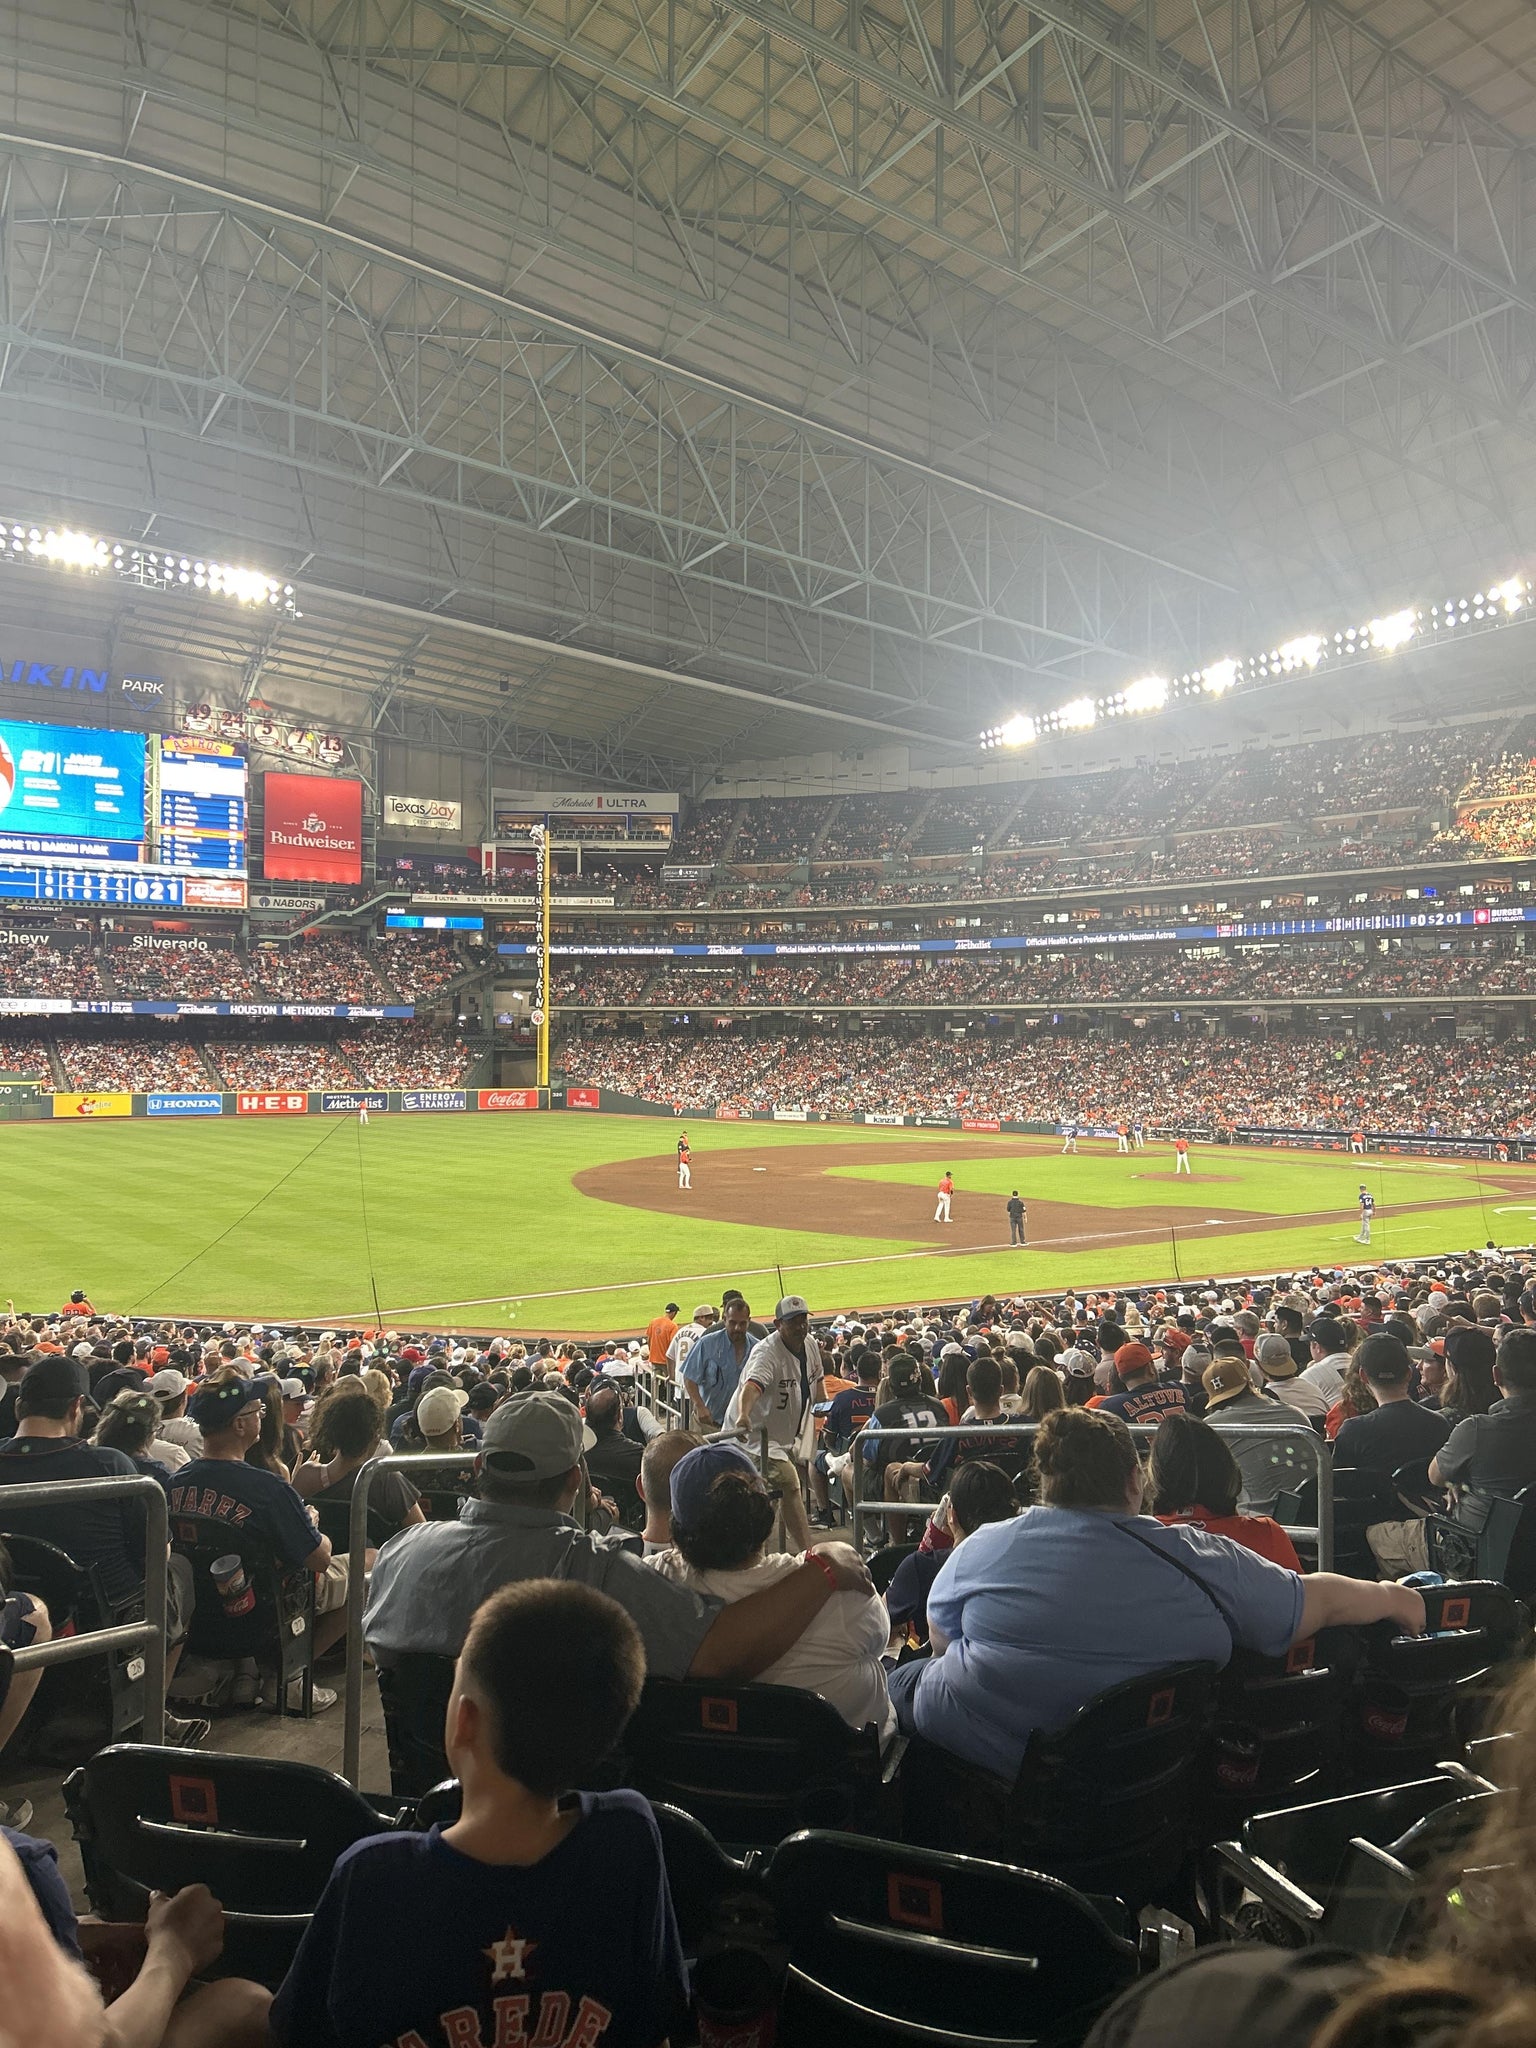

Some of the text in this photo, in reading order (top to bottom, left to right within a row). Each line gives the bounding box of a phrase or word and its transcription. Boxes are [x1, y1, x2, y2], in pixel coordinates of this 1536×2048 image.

[0, 660, 108, 693] IKIN
[122, 680, 165, 695] PARK
[188, 703, 211, 720] 49
[222, 711, 244, 728] 24
[262, 719, 273, 734] 5
[295, 729, 306, 743] 7
[322, 735, 343, 752] 13
[173, 738, 222, 755] ASTROS
[389, 798, 456, 821] Texas Bay
[552, 797, 647, 808] Michelob ULTRA
[25, 840, 40, 851] TO
[80, 844, 109, 856] PARK
[536, 852, 544, 891] ROOT
[273, 898, 316, 909] NABORS
[536, 896, 544, 907] 4
[1491, 908, 1523, 917] BURGER
[536, 911, 544, 943] THA
[1365, 919, 1371, 928] E
[0, 931, 49, 945] Chevy
[133, 935, 208, 950] Silverado
[1026, 938, 1047, 946] Official
[1049, 937, 1068, 945] Health
[1069, 936, 1083, 944] Care
[1118, 933, 1128, 941] the
[1129, 932, 1154, 941] Houston
[1156, 931, 1176, 939] Astros
[583, 946, 607, 954] Provider
[776, 946, 796, 954] Official
[798, 945, 816, 953] Health
[817, 945, 830, 953] Care
[832, 944, 855, 953] Provider
[866, 944, 875, 952] the
[876, 943, 900, 951] Houston
[230, 1005, 336, 1016] HOUSTON METHODIST
[163, 1099, 220, 1108] HONDA
[420, 1093, 456, 1101] ENERGY
[420, 1100, 464, 1108] TRANSFER
[487, 1092, 528, 1106] Coca-Cola
[1212, 1376, 1224, 1390] H
[777, 1393, 789, 1410] 3
[1123, 1388, 1186, 1416] ALTUVE
[168, 1486, 253, 1528] VAREZ
[131, 1661, 142, 1676] 28
[491, 1938, 526, 1981] H
